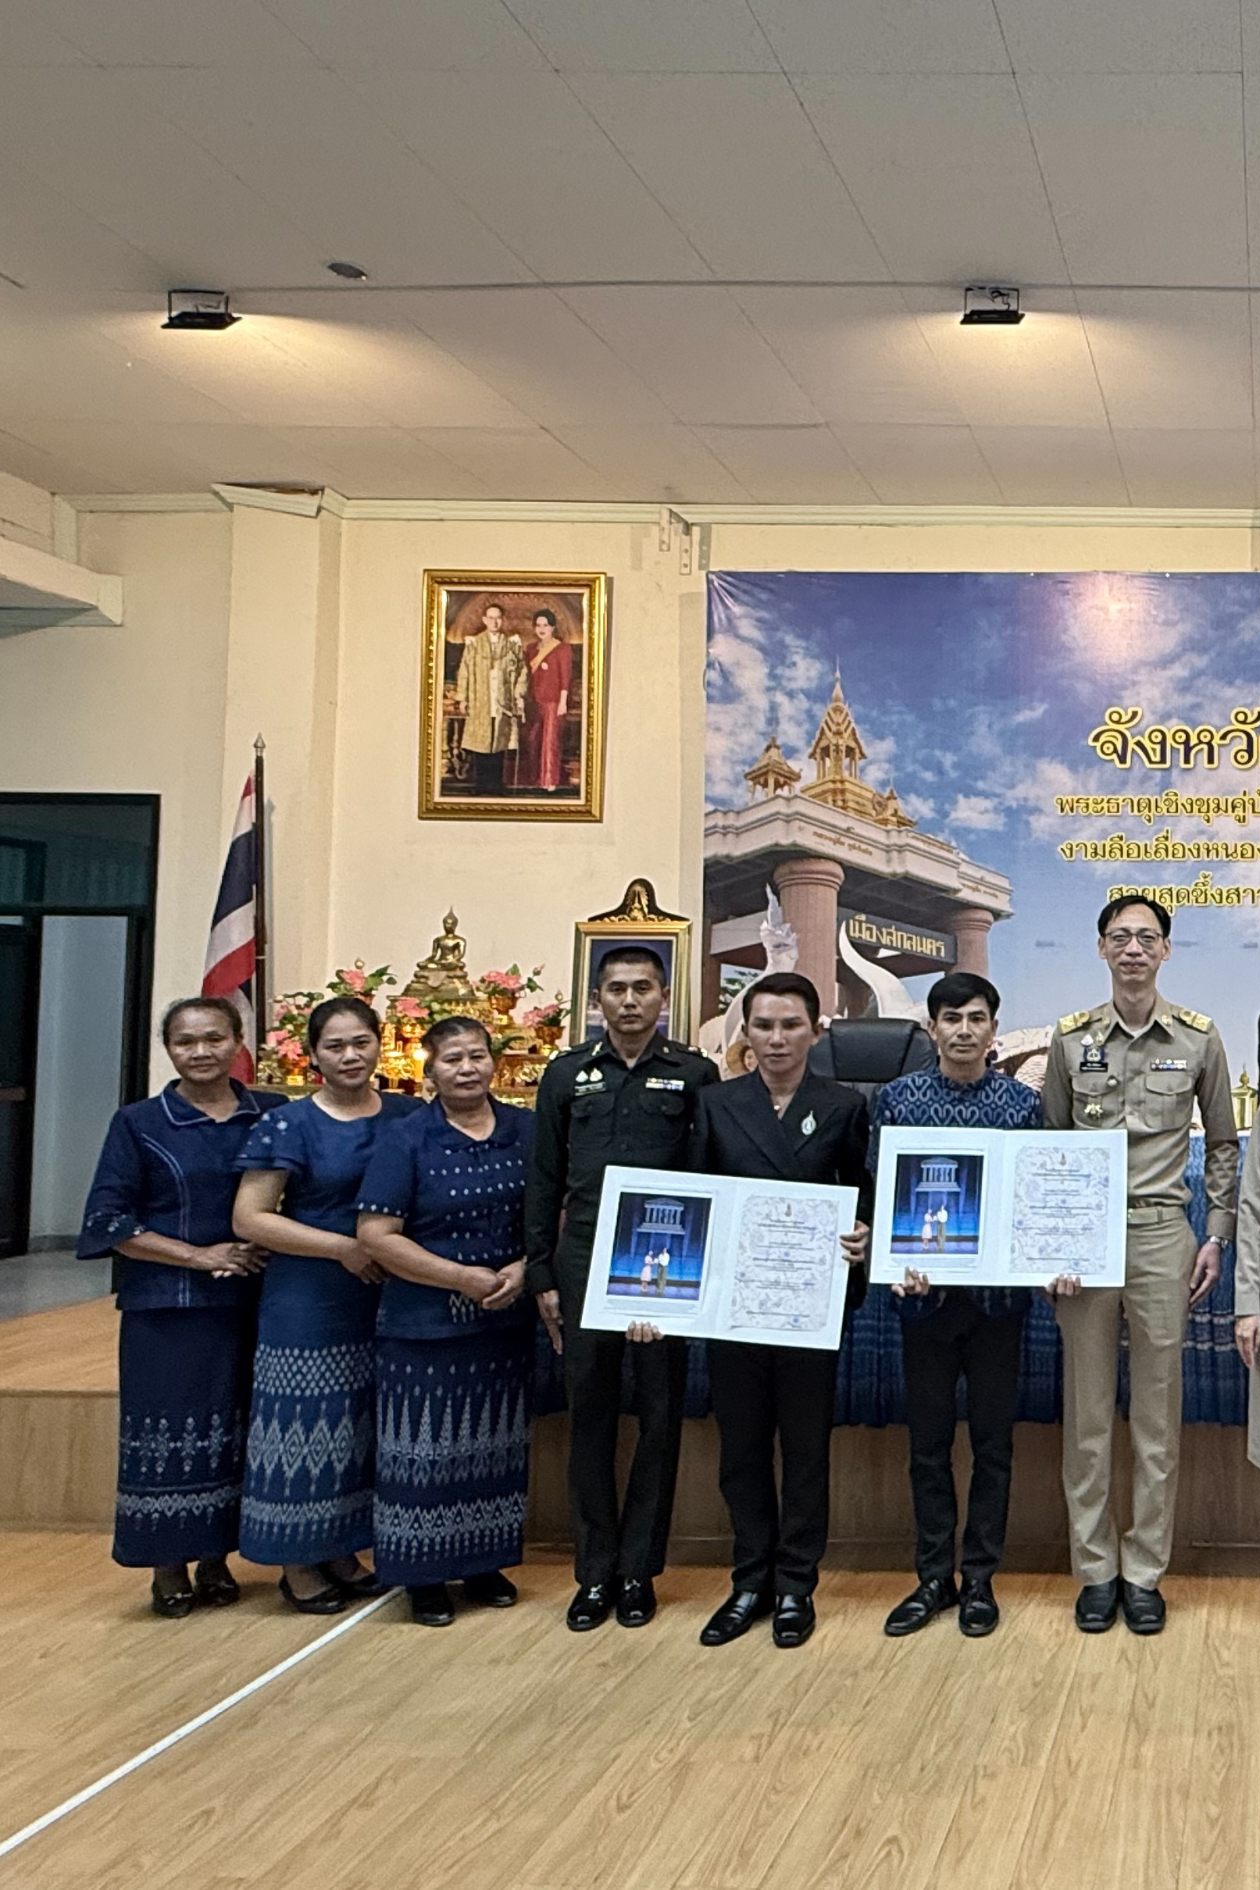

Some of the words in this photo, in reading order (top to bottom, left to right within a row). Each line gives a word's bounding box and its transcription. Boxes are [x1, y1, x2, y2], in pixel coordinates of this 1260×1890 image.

[849, 914, 945, 958] เมืองสกลนคร
